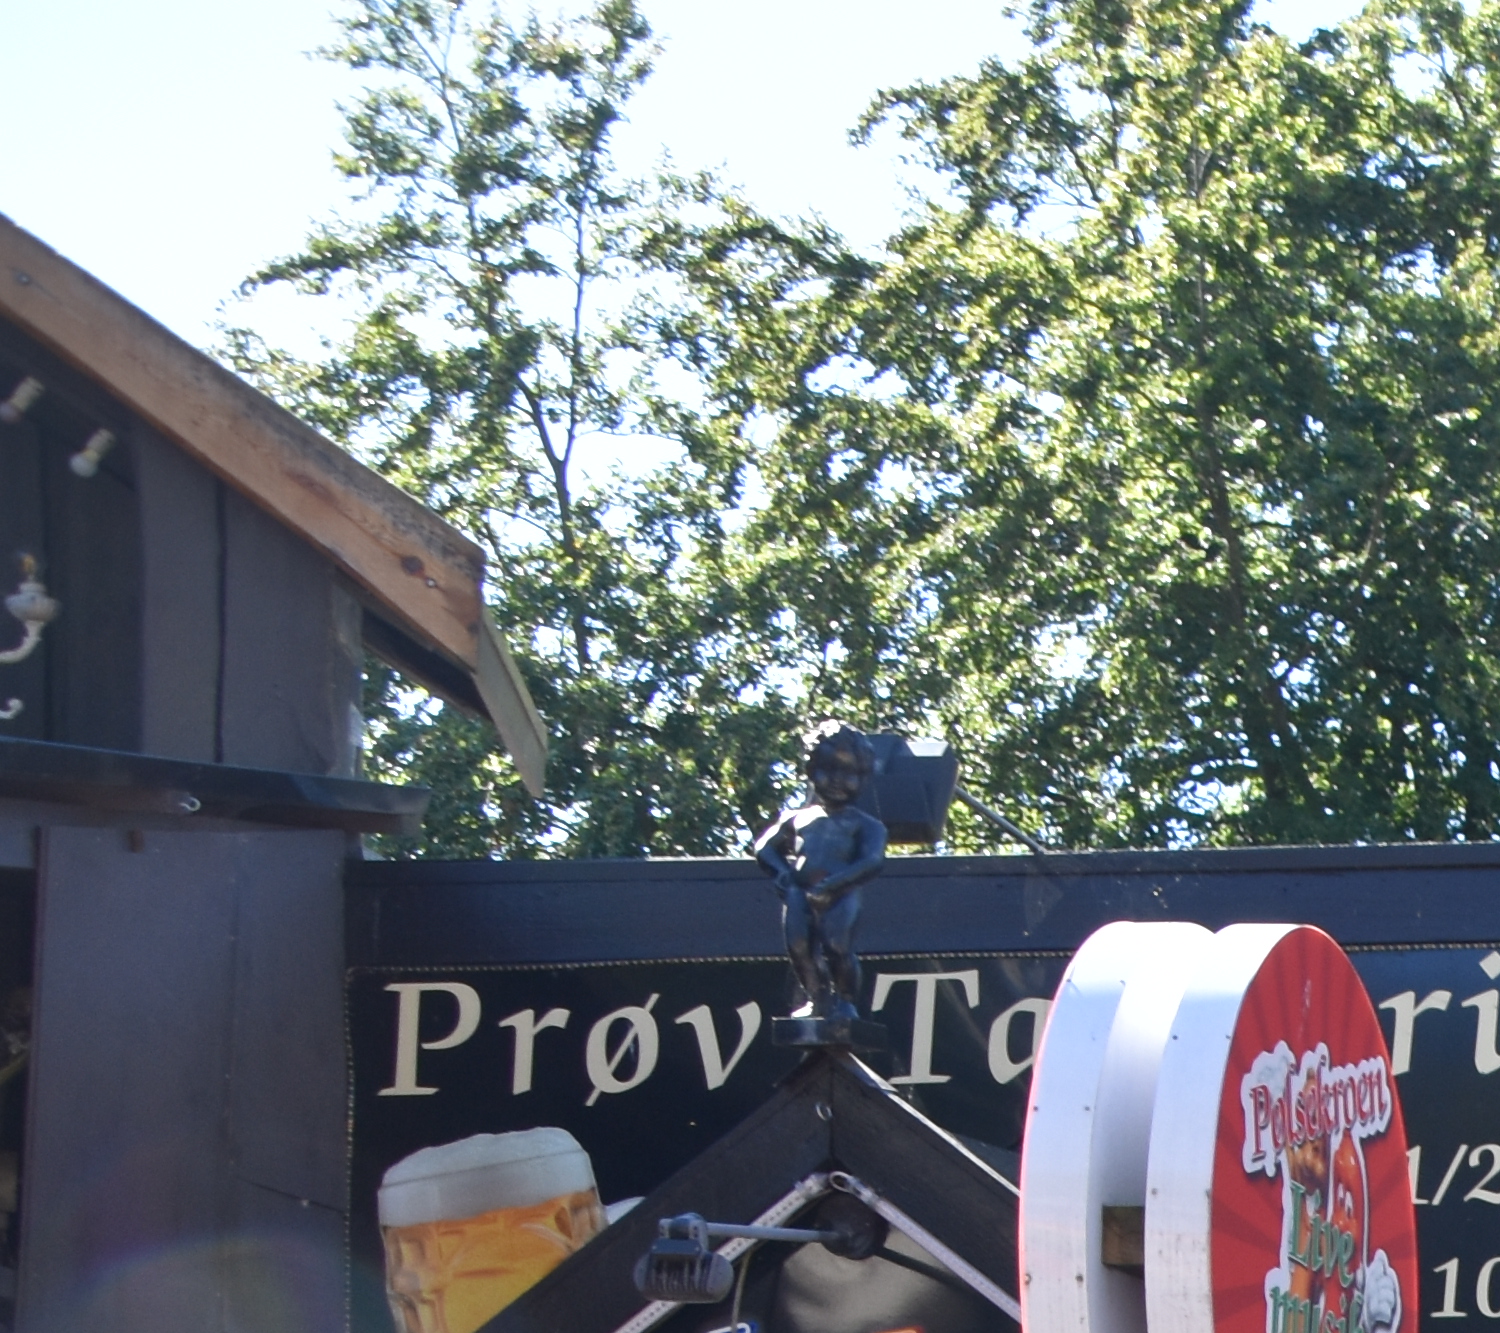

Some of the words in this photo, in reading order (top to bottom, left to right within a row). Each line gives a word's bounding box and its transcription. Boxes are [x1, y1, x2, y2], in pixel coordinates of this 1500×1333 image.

[376, 977, 766, 1098] Prøv
[1248, 1056, 1385, 1158] Pølsekroen
[1288, 1182, 1354, 1288] Live
